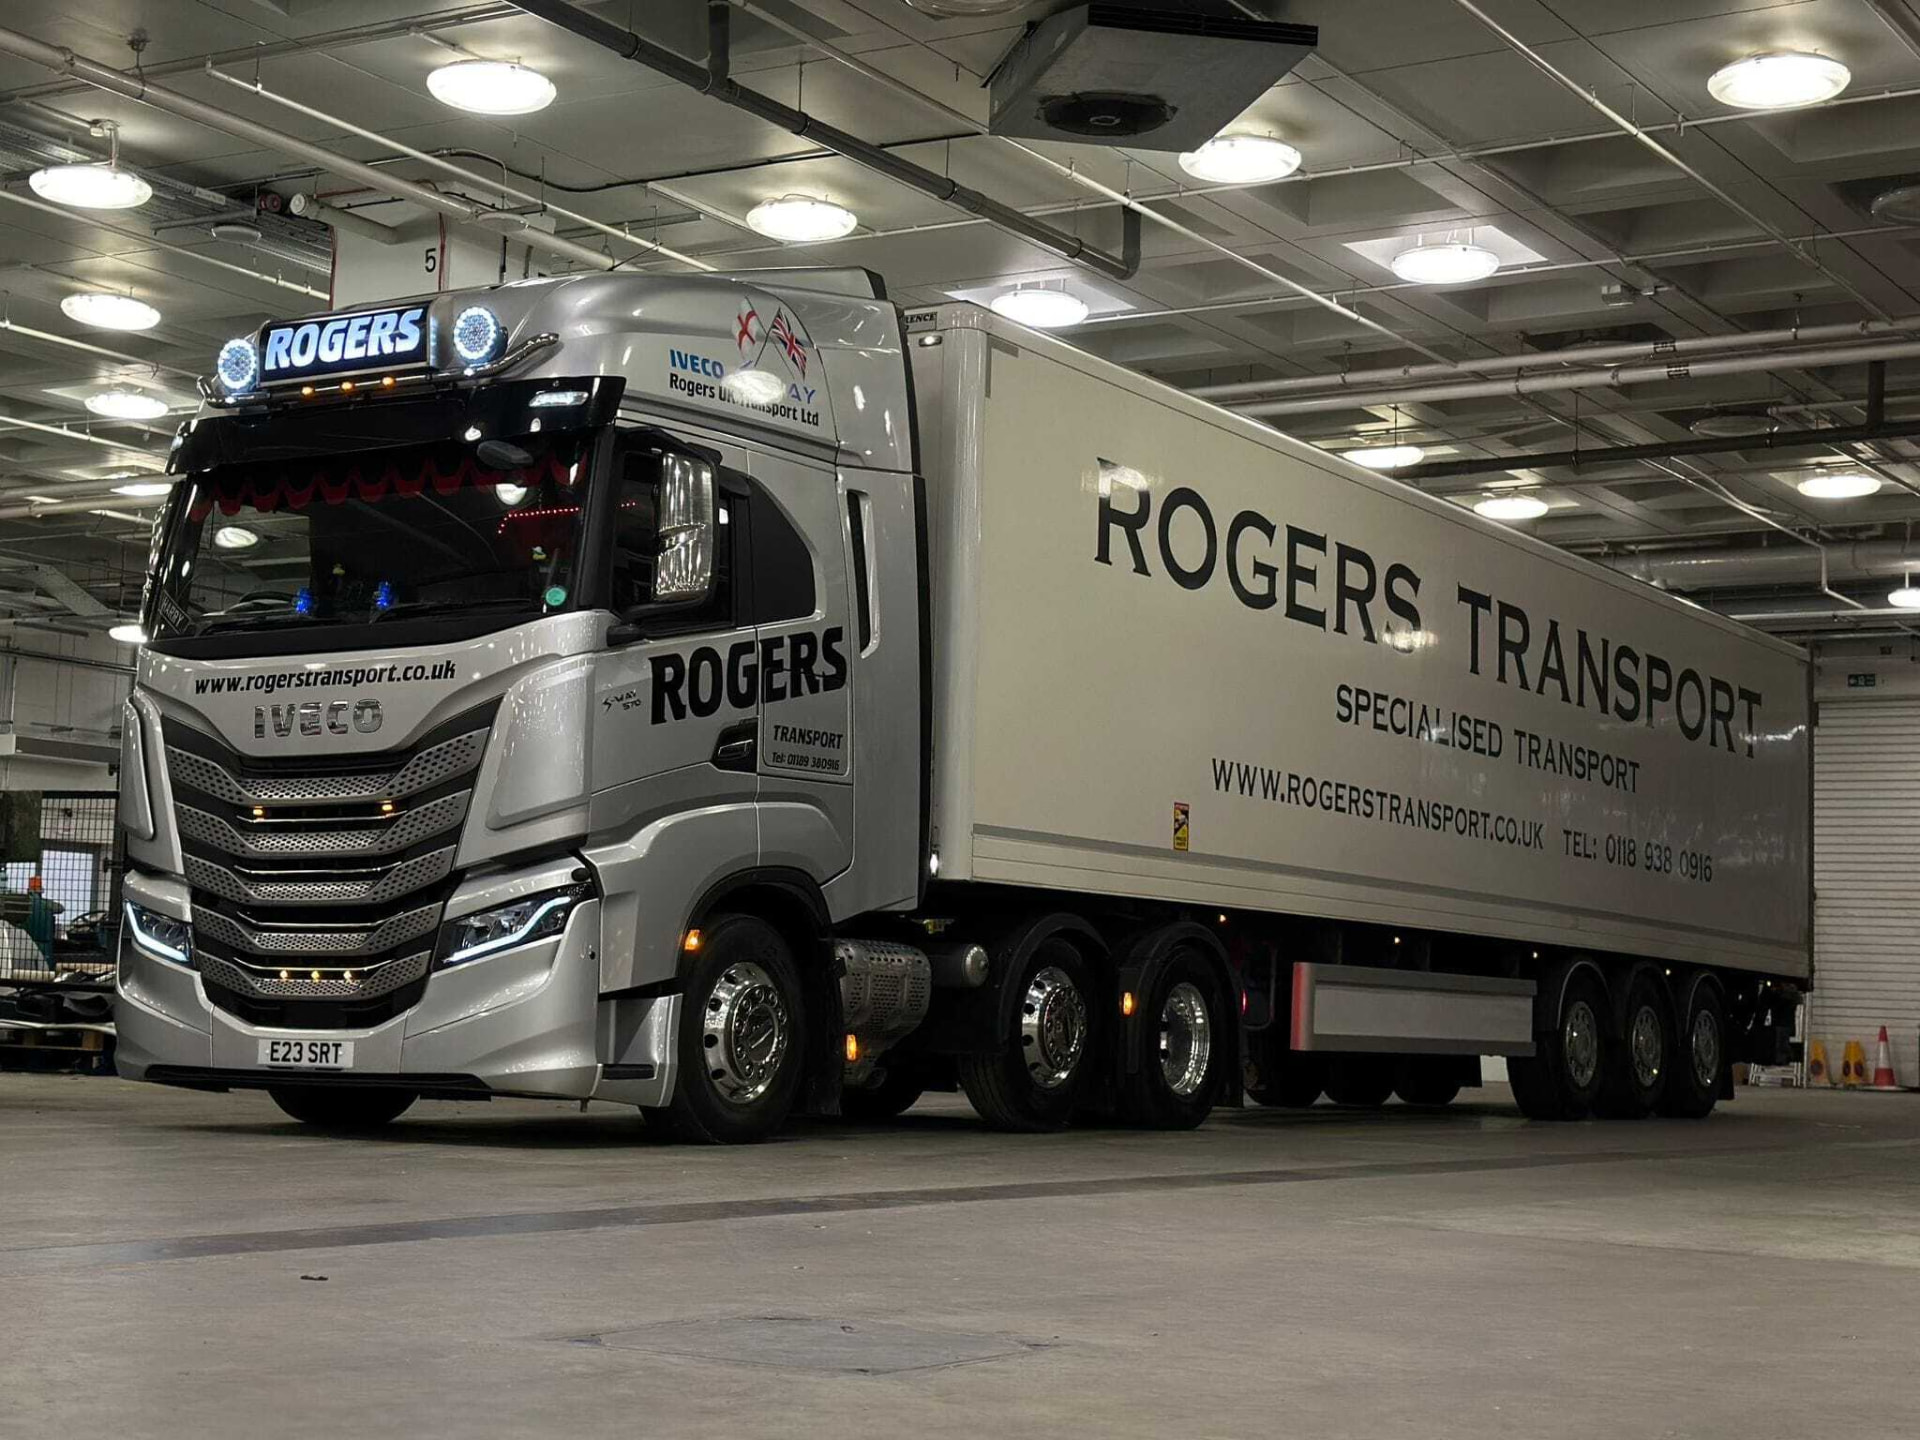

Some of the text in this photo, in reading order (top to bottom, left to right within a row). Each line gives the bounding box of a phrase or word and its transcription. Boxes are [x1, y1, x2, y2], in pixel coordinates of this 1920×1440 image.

[424, 248, 437, 273] 5
[264, 308, 424, 371] ROGERS
[669, 349, 725, 379] IVECO
[669, 373, 715, 400] Rogers
[739, 391, 797, 421] sport
[801, 408, 819, 427] Ltd
[1094, 457, 1762, 759] ROGERS TRANSPORT
[195, 660, 457, 694] www.rogerstransport.co.uk
[648, 626, 847, 725] ROGERS
[254, 699, 383, 738] IVECO
[773, 725, 844, 750] TRANSPORT
[1336, 684, 1640, 793] SPECIALISED TRANSPORT
[1212, 758, 1713, 882] WWW.ROGERSTRANSPORT.CO.UK TEL: 0118 938 0916
[270, 1041, 342, 1064] E23 SRT
